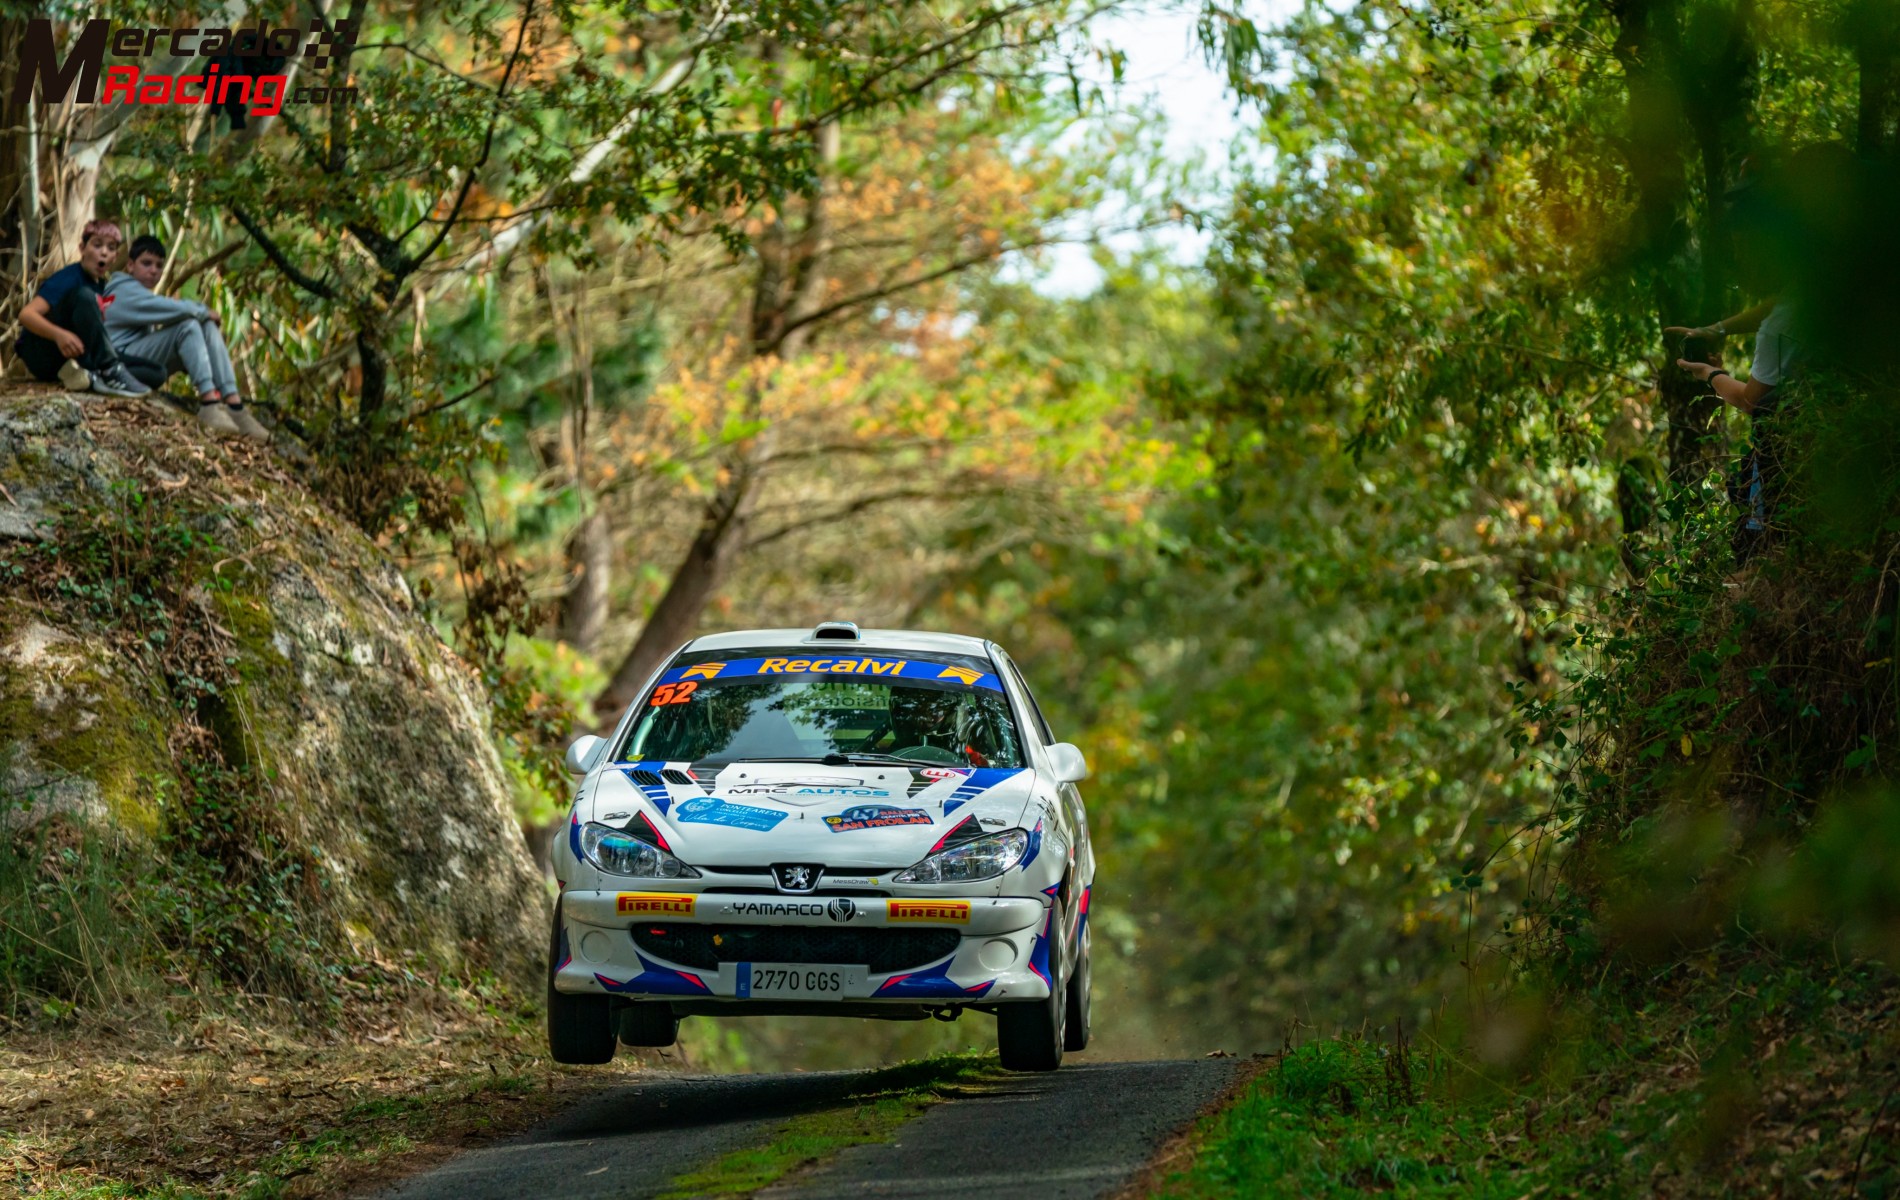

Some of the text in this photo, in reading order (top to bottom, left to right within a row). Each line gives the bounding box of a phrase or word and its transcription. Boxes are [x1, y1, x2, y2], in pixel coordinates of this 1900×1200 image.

[757, 657, 907, 676] Recalvi
[650, 681, 698, 707] 52
[796, 788, 890, 797] AUTOS
[720, 803, 783, 817] PONTEAREAS
[852, 808, 879, 821] 47
[832, 820, 865, 832] SAN
[619, 896, 693, 913] PIRELLI
[733, 902, 824, 916] YAMARCO
[890, 902, 969, 919] PIRELLI
[752, 970, 840, 992] 2770 CGS
